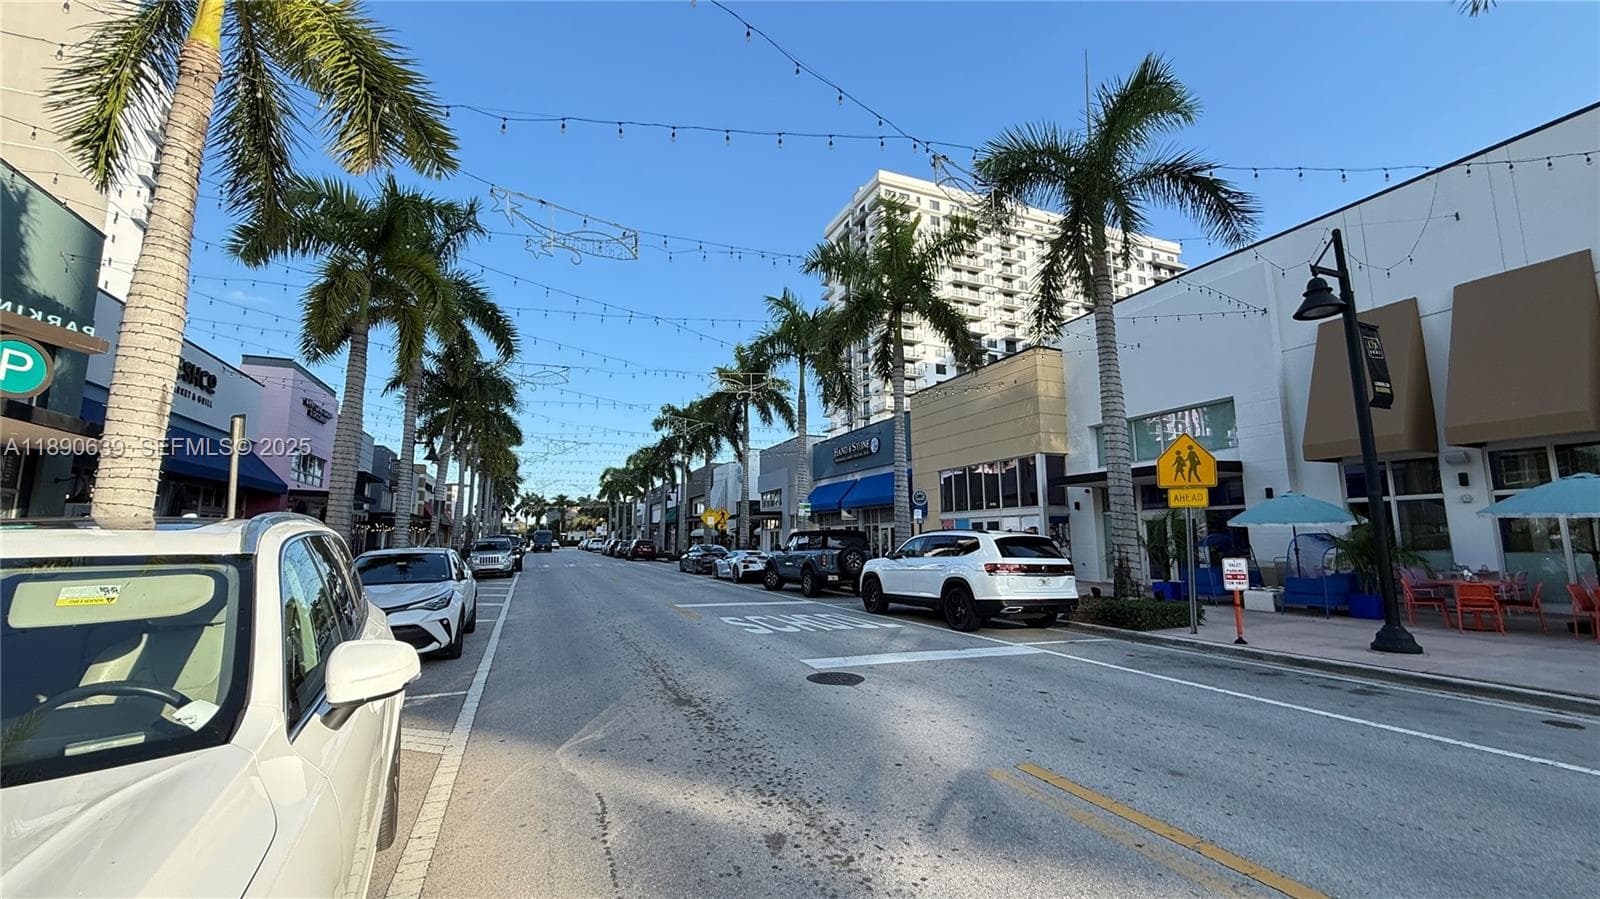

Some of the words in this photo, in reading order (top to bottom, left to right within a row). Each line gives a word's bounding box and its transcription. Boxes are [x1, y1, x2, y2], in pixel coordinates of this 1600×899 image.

[0, 347, 34, 381] P
[197, 395, 212, 408] GRILL
[1174, 493, 1203, 502] AHEAD
[720, 612, 904, 634] SCHOOL
